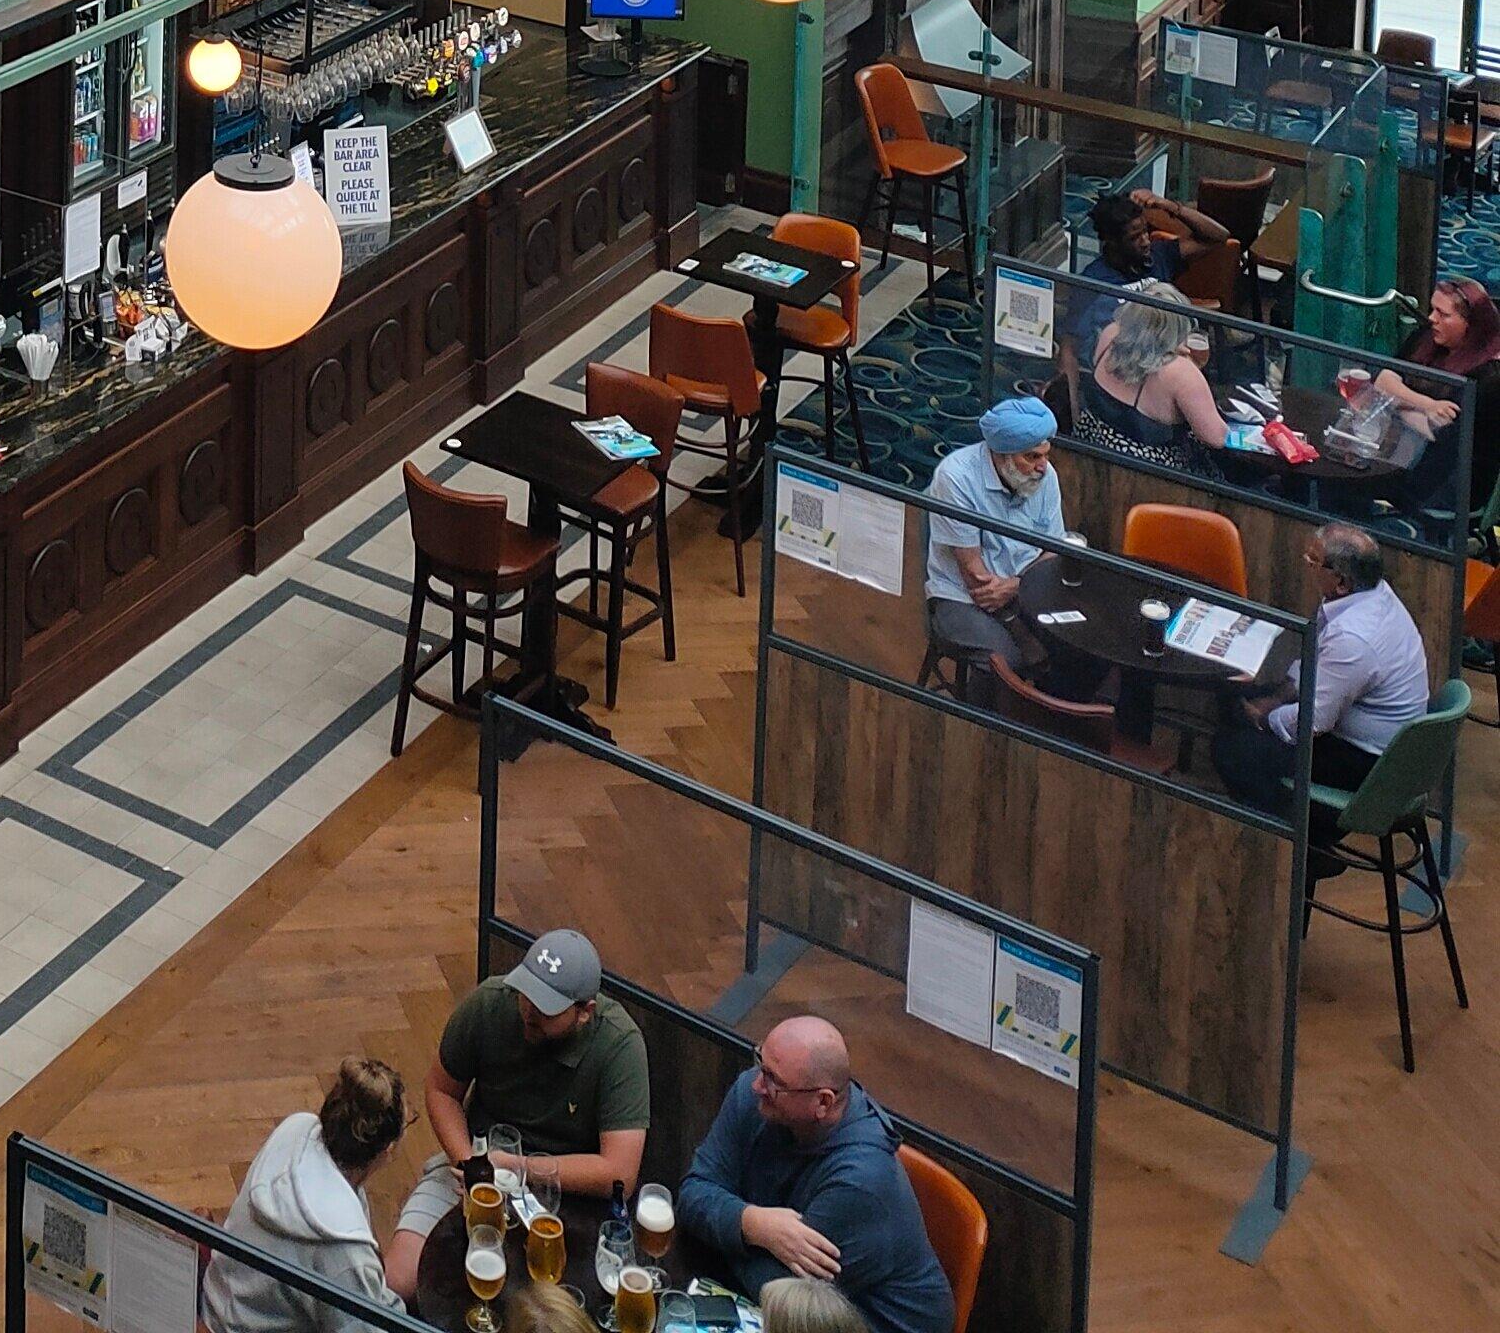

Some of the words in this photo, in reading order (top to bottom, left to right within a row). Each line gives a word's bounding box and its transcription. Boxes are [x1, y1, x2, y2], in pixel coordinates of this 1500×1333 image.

[335, 138, 359, 149] KEEP
[360, 136, 378, 147] THE
[334, 150, 353, 161] BAR
[355, 149, 380, 160] AREA
[343, 161, 372, 173] CLEAR
[341, 178, 375, 190] PLEASE
[336, 190, 368, 203] QUEUE
[370, 190, 381, 200] AT
[340, 204, 357, 215] THE
[360, 202, 378, 213] TILL
